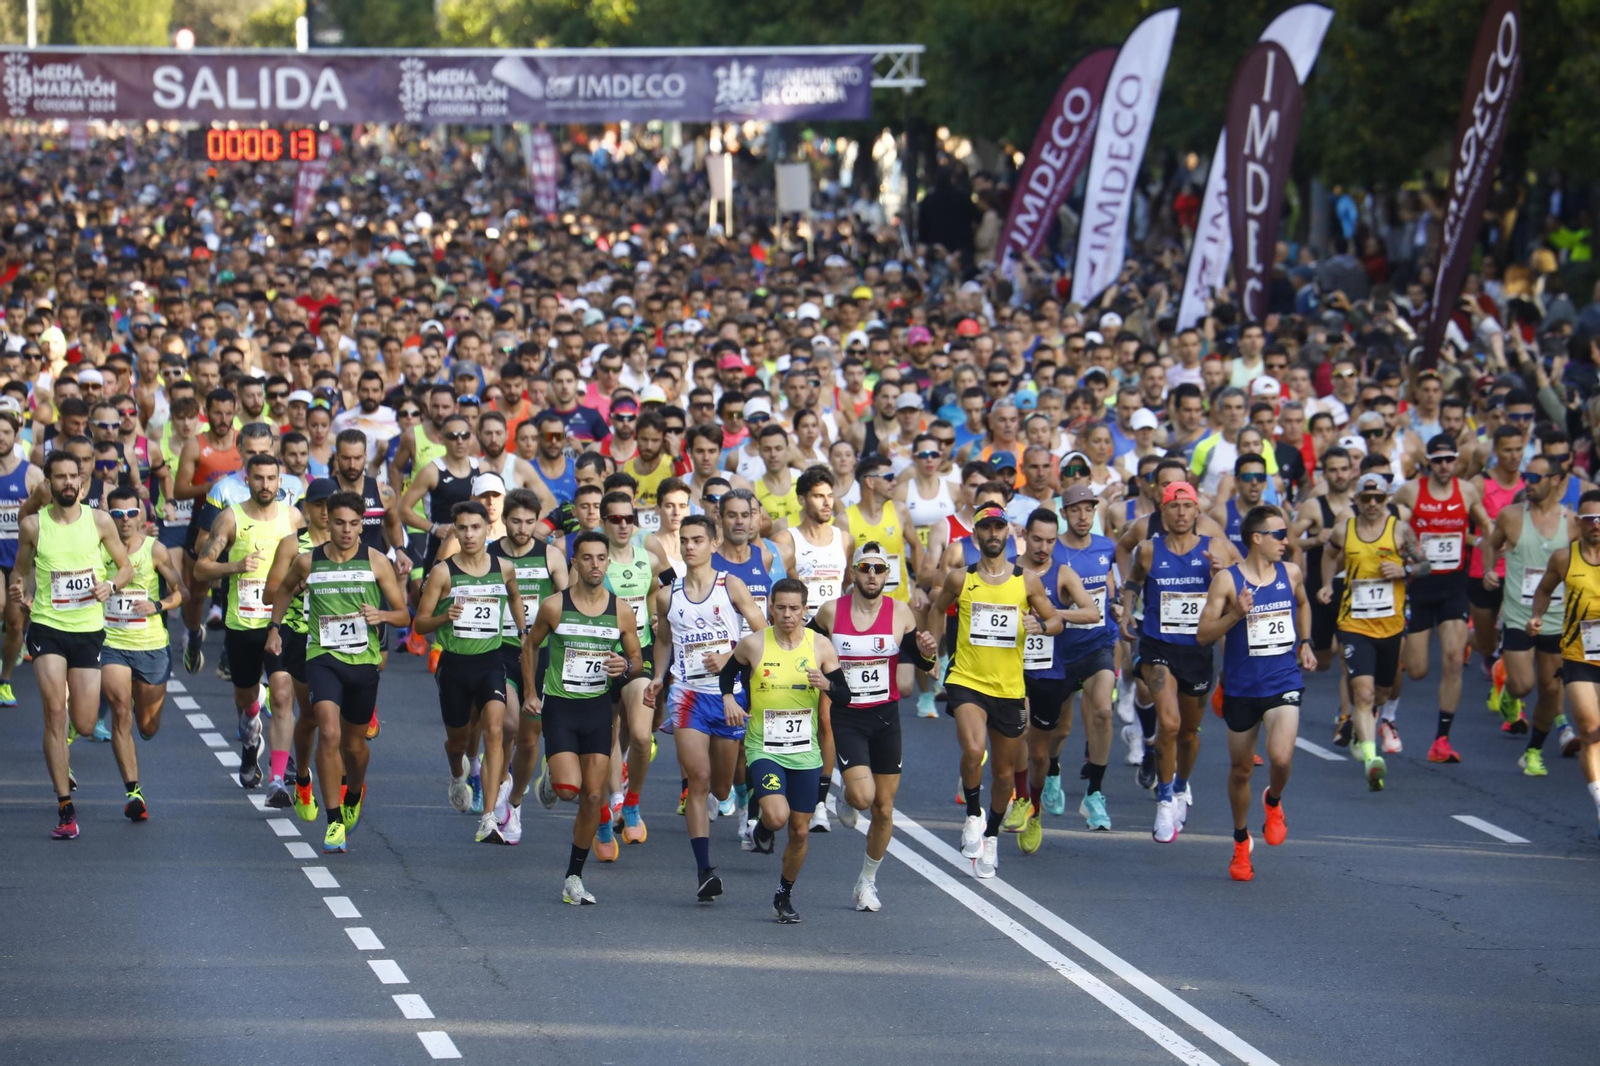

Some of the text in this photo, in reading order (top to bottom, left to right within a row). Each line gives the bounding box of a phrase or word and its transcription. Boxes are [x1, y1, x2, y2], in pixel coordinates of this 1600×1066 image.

[33, 63, 84, 80] MEDIA
[427, 68, 478, 86] MEDIA
[33, 75, 117, 97] MARATÓN
[152, 66, 348, 111] SALIDA
[428, 79, 509, 102] MARATÓN
[578, 73, 687, 99] IMDECO
[1011, 86, 1092, 246] IMDECO
[1089, 74, 1142, 252] IMDECO
[0, 512, 17, 523] 08
[645, 514, 658, 526] 56
[1438, 542, 1453, 553] 55
[66, 578, 90, 591] 403
[1155, 577, 1205, 586] TROTASIERRA
[819, 585, 833, 597] 63
[1368, 588, 1384, 599] 17
[474, 606, 491, 619] 23
[1181, 602, 1198, 615] 28
[991, 614, 1008, 627] 62
[340, 622, 356, 636] 21
[1268, 621, 1285, 635] 26
[1027, 638, 1044, 651] 33
[586, 660, 602, 674] 76
[861, 669, 879, 683] 64
[786, 719, 803, 733] 37
